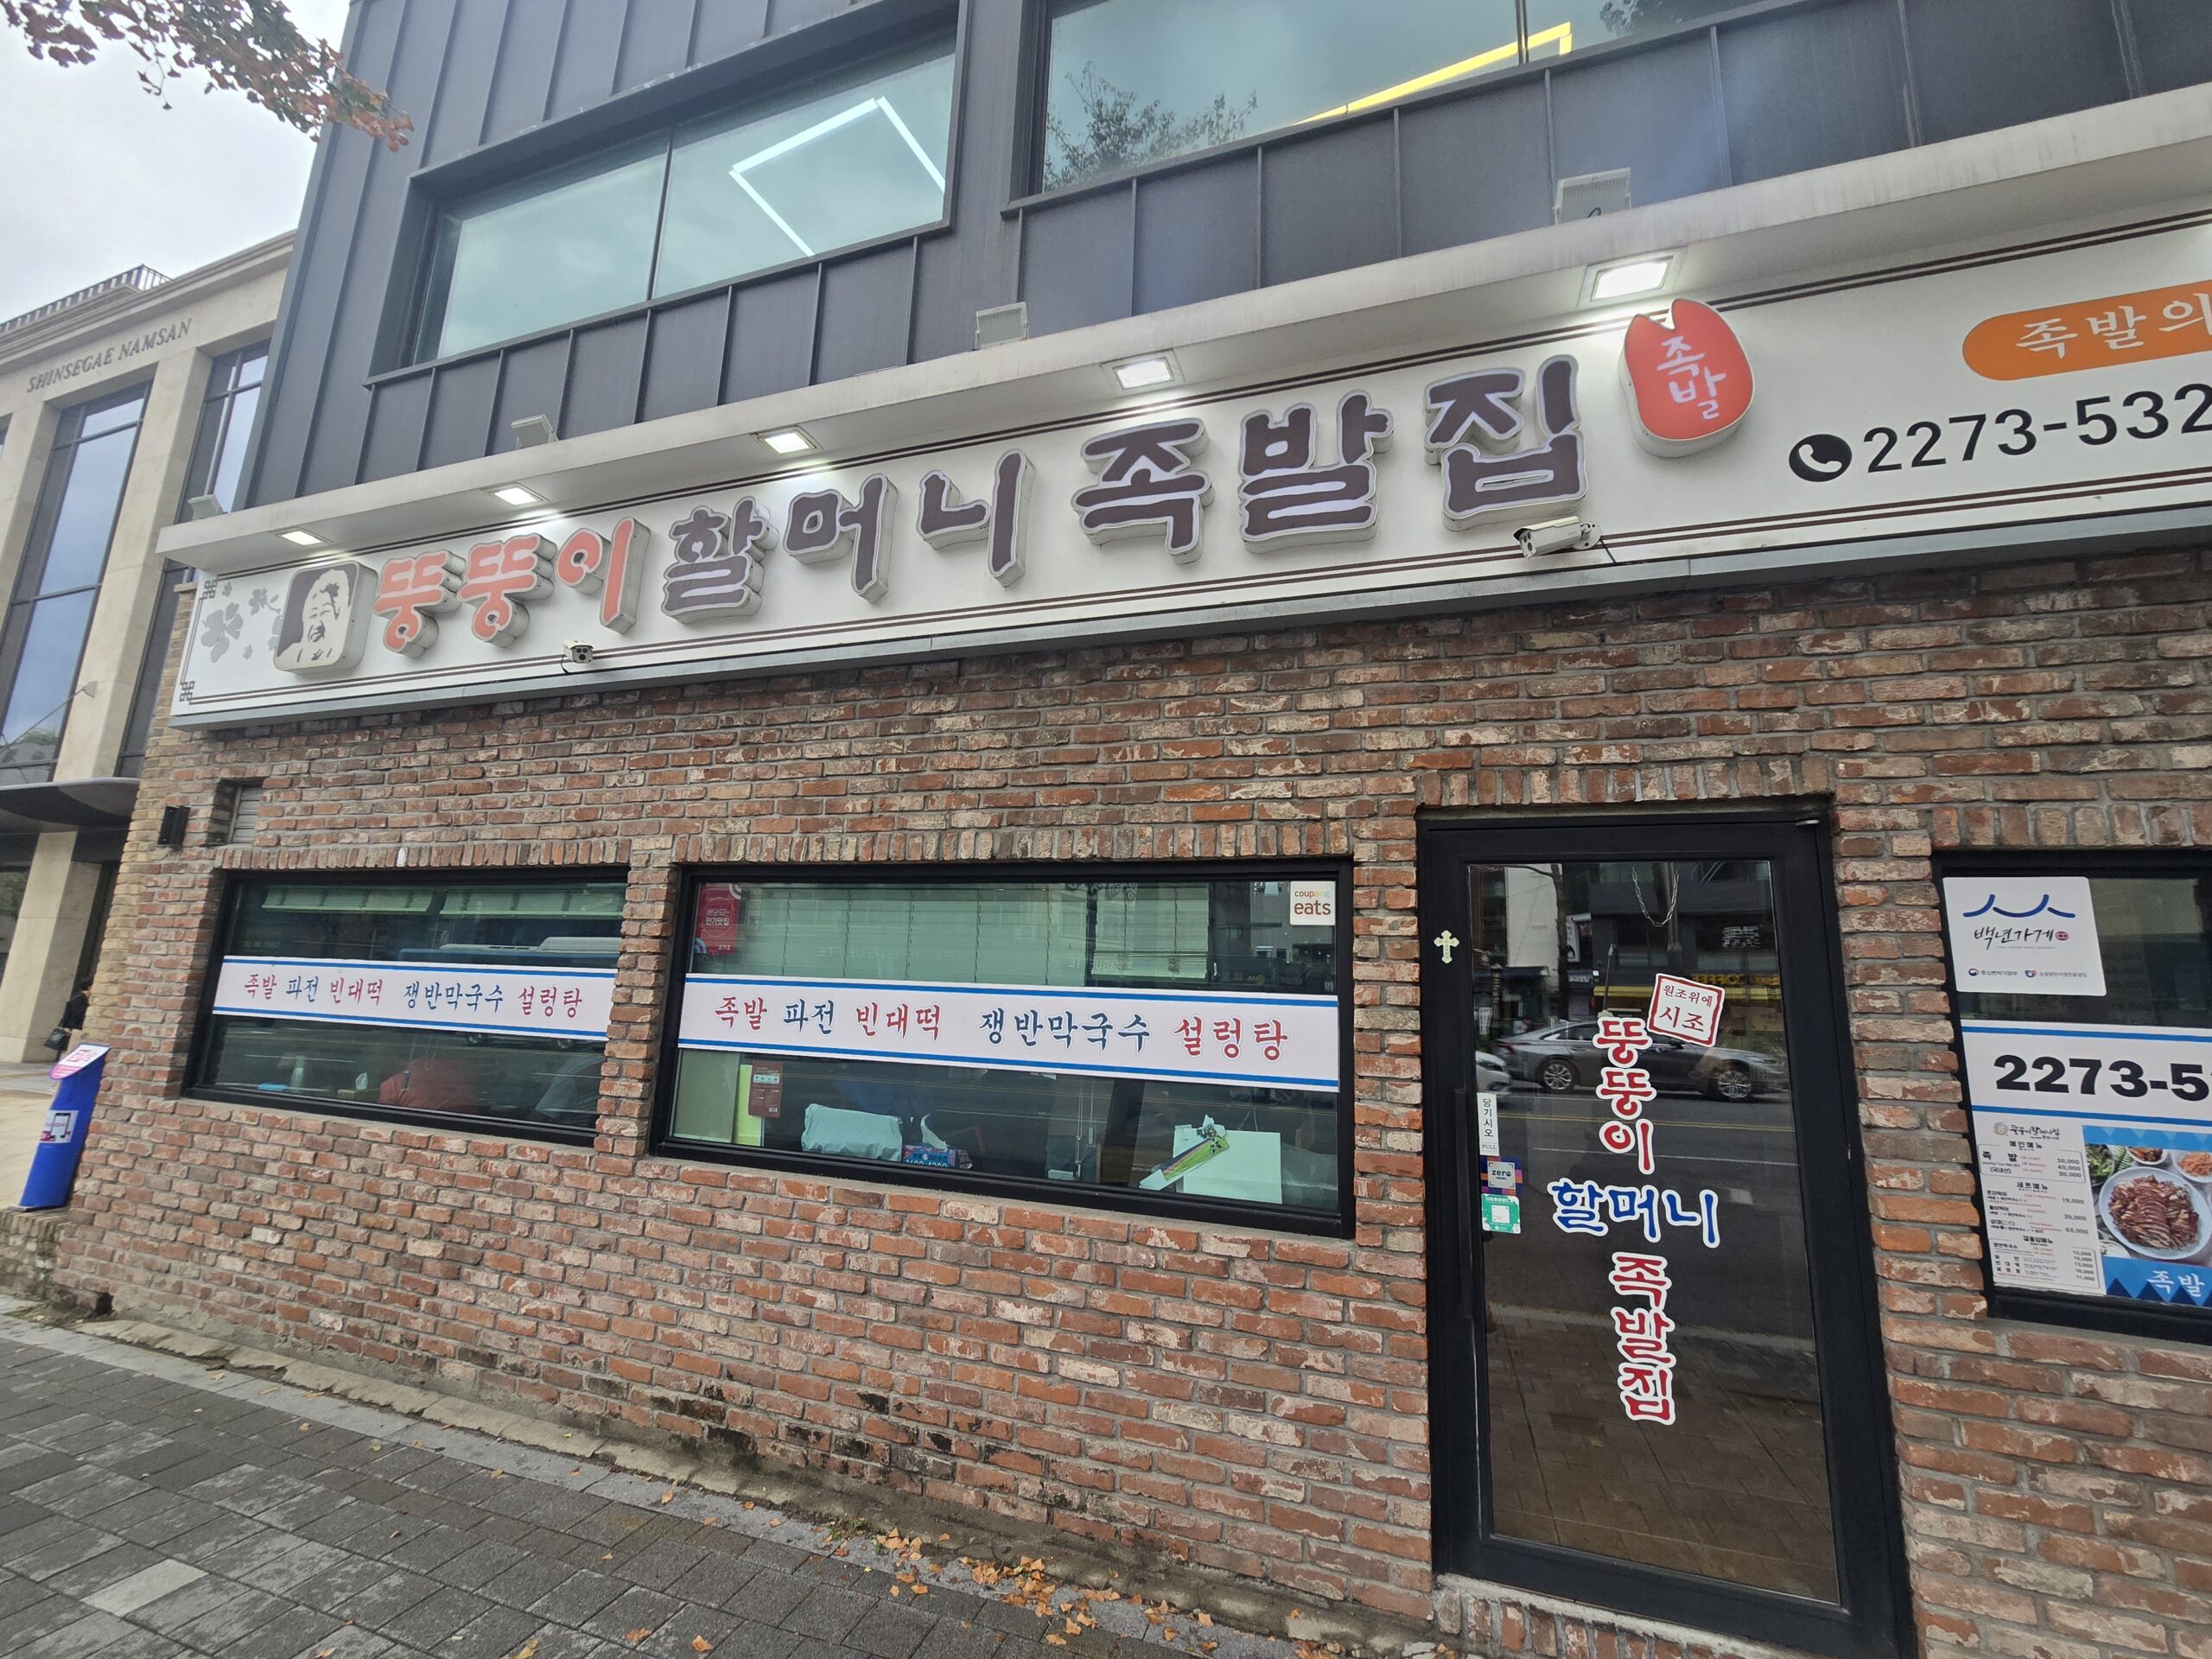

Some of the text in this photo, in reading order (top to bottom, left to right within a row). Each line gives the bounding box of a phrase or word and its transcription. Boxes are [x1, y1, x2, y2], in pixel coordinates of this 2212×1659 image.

[2015, 293, 2212, 359] 족발의
[27, 318, 192, 393] SHINSEGAE NAMSAN
[1863, 383, 2212, 473] 2273-532
[373, 355, 1588, 657] 뚱뚱이 할머니 족발집
[705, 917, 730, 926] 인기맛집
[1294, 900, 1332, 916] eats
[1974, 926, 2055, 950] 백년가게
[244, 973, 583, 1019] 족발 파전 빈대떡 쟁반막국수 설렁탕
[1657, 1005, 1705, 1033] 시조
[1662, 984, 1713, 1008] 원조위에
[714, 995, 1288, 1062] 족발 파전 빈대떡 쟁반막국수 설렁탕
[1596, 1020, 1654, 1173] 뚱뚱이
[1993, 1054, 2212, 1102] 2273-5
[1482, 1098, 1494, 1137] 당기시오
[1551, 1179, 1717, 1245] 할머니
[2146, 1270, 2206, 1298] 족발
[1611, 1255, 1673, 1422] 족발집
